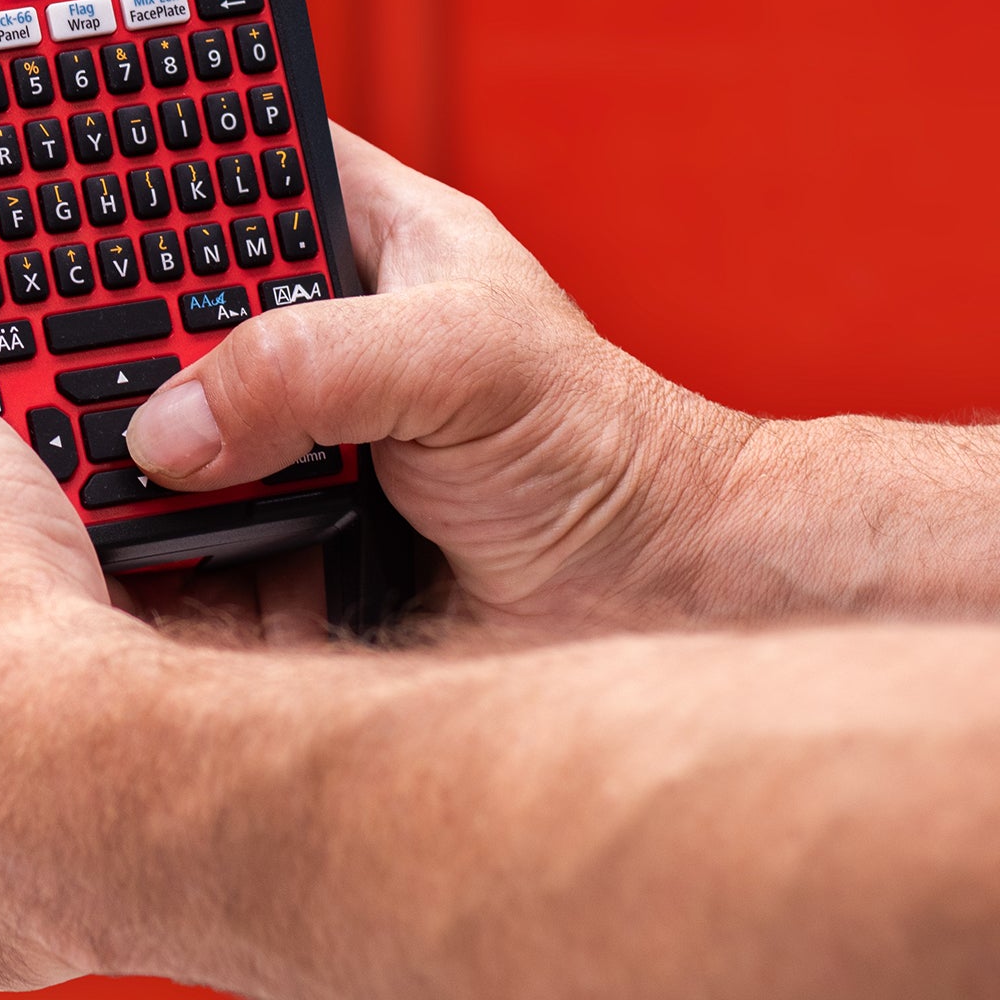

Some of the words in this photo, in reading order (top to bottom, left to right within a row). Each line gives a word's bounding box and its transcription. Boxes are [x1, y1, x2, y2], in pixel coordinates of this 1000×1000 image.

[67, 17, 101, 32] Wrap
[68, 2, 95, 19] Flag
[130, 4, 186, 23] FacePlate
[29, 76, 43, 95] 5
[75, 69, 89, 88] 6
[118, 62, 131, 82] 7
[163, 56, 178, 74] 8
[207, 49, 221, 68] 9
[253, 43, 266, 62] 0
[41, 139, 56, 159] T
[86, 132, 102, 152] Y
[131, 125, 147, 145] U
[180, 119, 188, 138] I
[220, 112, 237, 131] O
[265, 106, 279, 125] P
[11, 209, 24, 228] F
[55, 201, 72, 221] G
[100, 194, 117, 214] H
[150, 188, 157, 207] J
[190, 180, 207, 200] K
[235, 175, 250, 194] L
[23, 272, 41, 293] X
[69, 265, 85, 284] C
[112, 258, 128, 278] V
[160, 252, 175, 271] B
[203, 244, 221, 264] N
[245, 237, 267, 258] M
